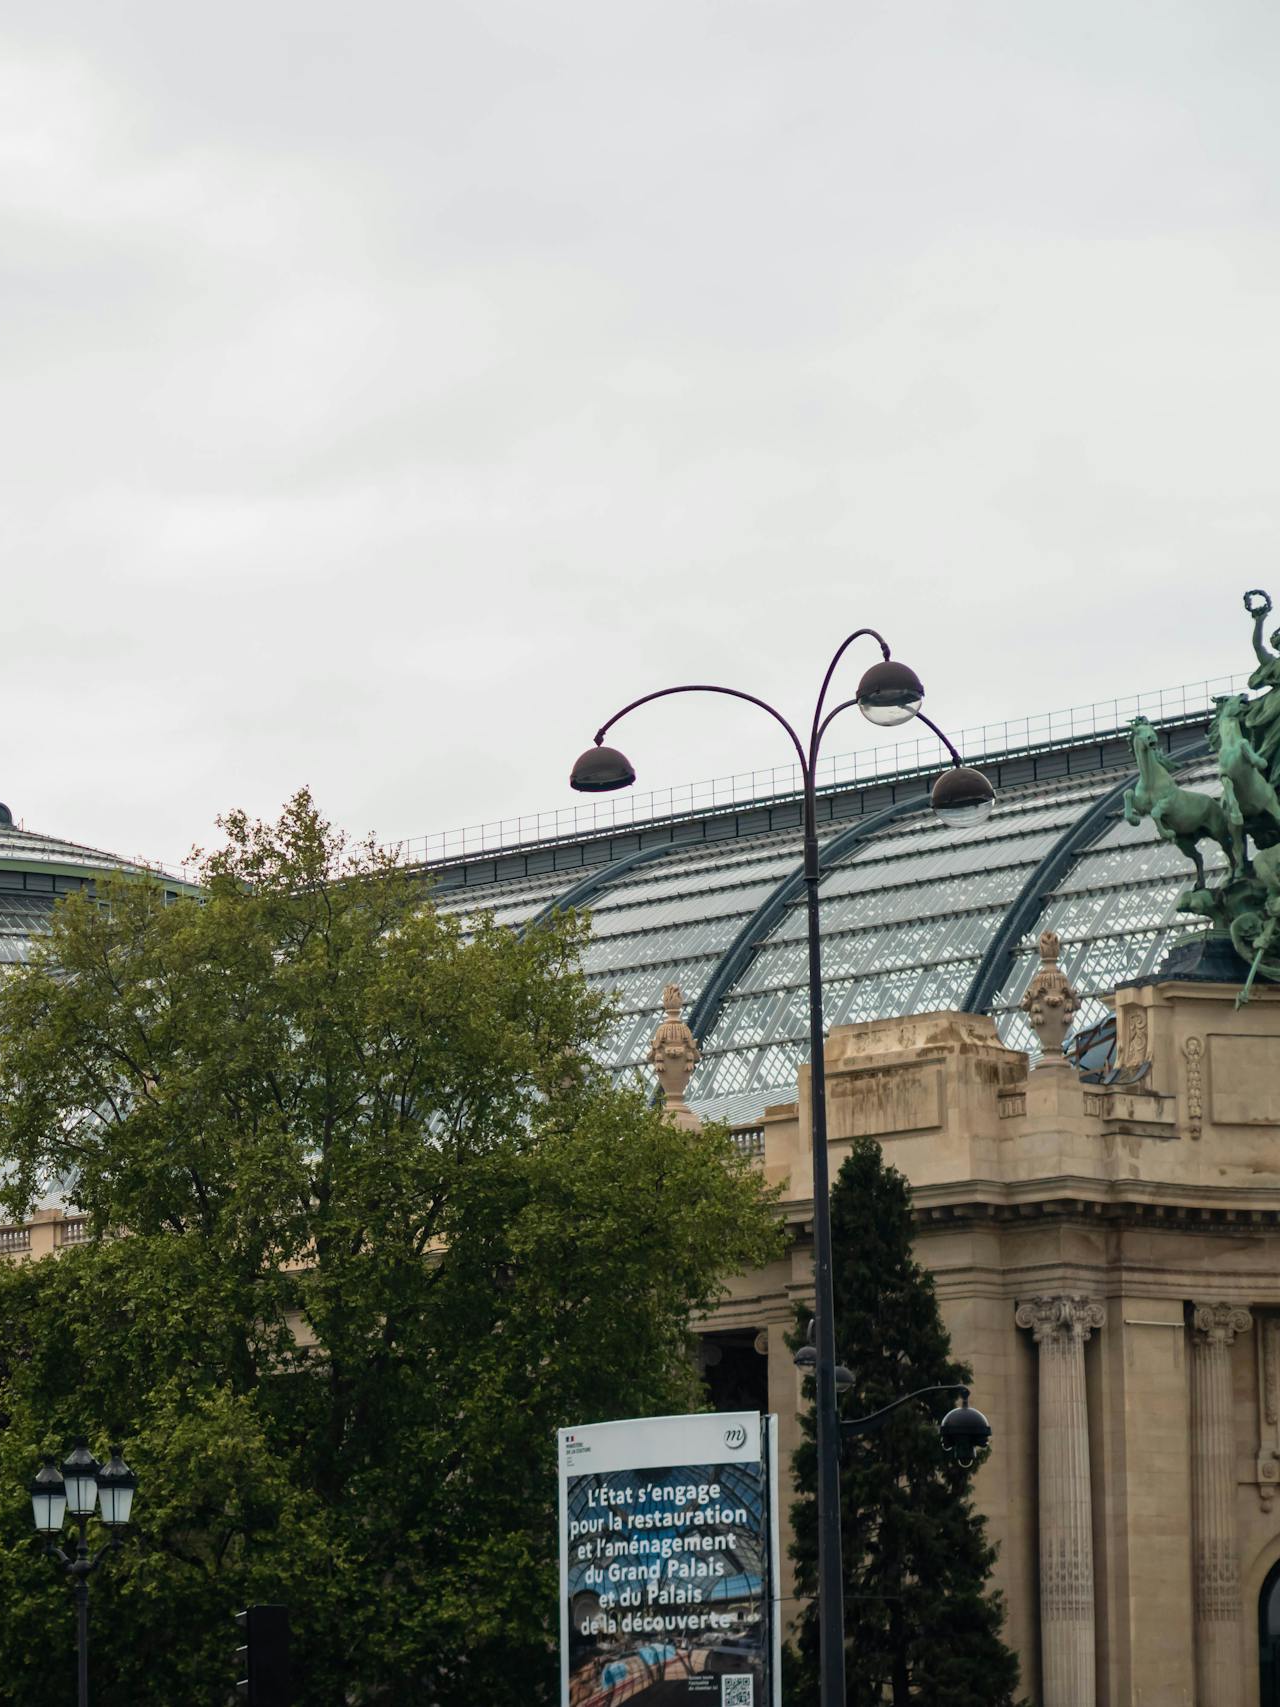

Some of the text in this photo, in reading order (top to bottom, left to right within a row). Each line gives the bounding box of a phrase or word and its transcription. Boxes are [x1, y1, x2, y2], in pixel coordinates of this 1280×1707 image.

[588, 1483, 721, 1508] L'État s'engage
[570, 1505, 747, 1540] pour la restauration
[577, 1533, 737, 1559] et l'aménagement
[585, 1557, 724, 1584] du Grand Palais
[599, 1584, 702, 1608] et du Palais
[581, 1611, 731, 1635] de la découverte
